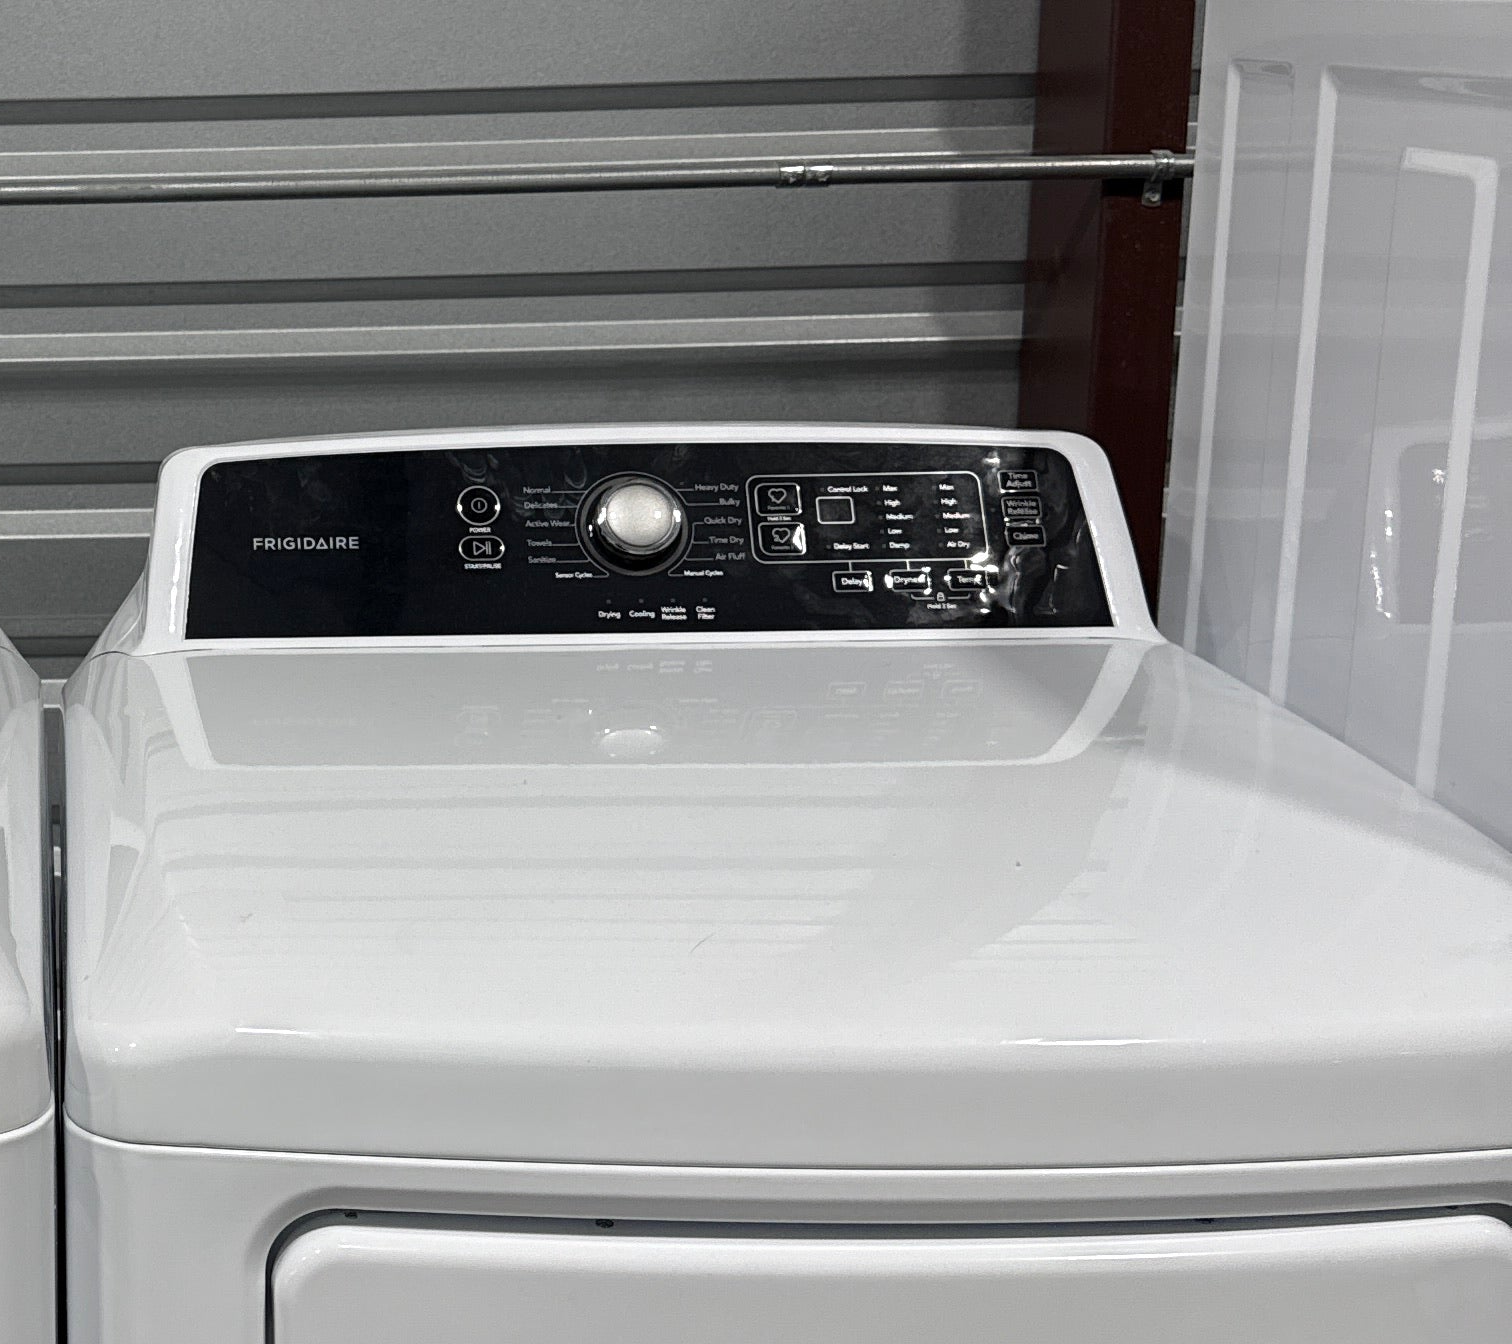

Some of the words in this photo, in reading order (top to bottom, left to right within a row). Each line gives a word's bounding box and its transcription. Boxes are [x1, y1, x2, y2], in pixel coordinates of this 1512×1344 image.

[523, 486, 551, 494] Normal
[695, 484, 719, 492] Heavy
[720, 483, 739, 492] Duty
[719, 498, 740, 507] Bulky
[704, 517, 726, 525] Quick
[728, 517, 742, 525] Dry
[253, 536, 359, 551] FRIGIDAIRE
[527, 539, 552, 547] Towels
[708, 536, 728, 544] Time
[729, 537, 744, 545] Dry
[728, 552, 745, 560] Fluff
[841, 577, 862, 587] Delay
[598, 611, 621, 619] Drying
[629, 610, 655, 618] Cooling
